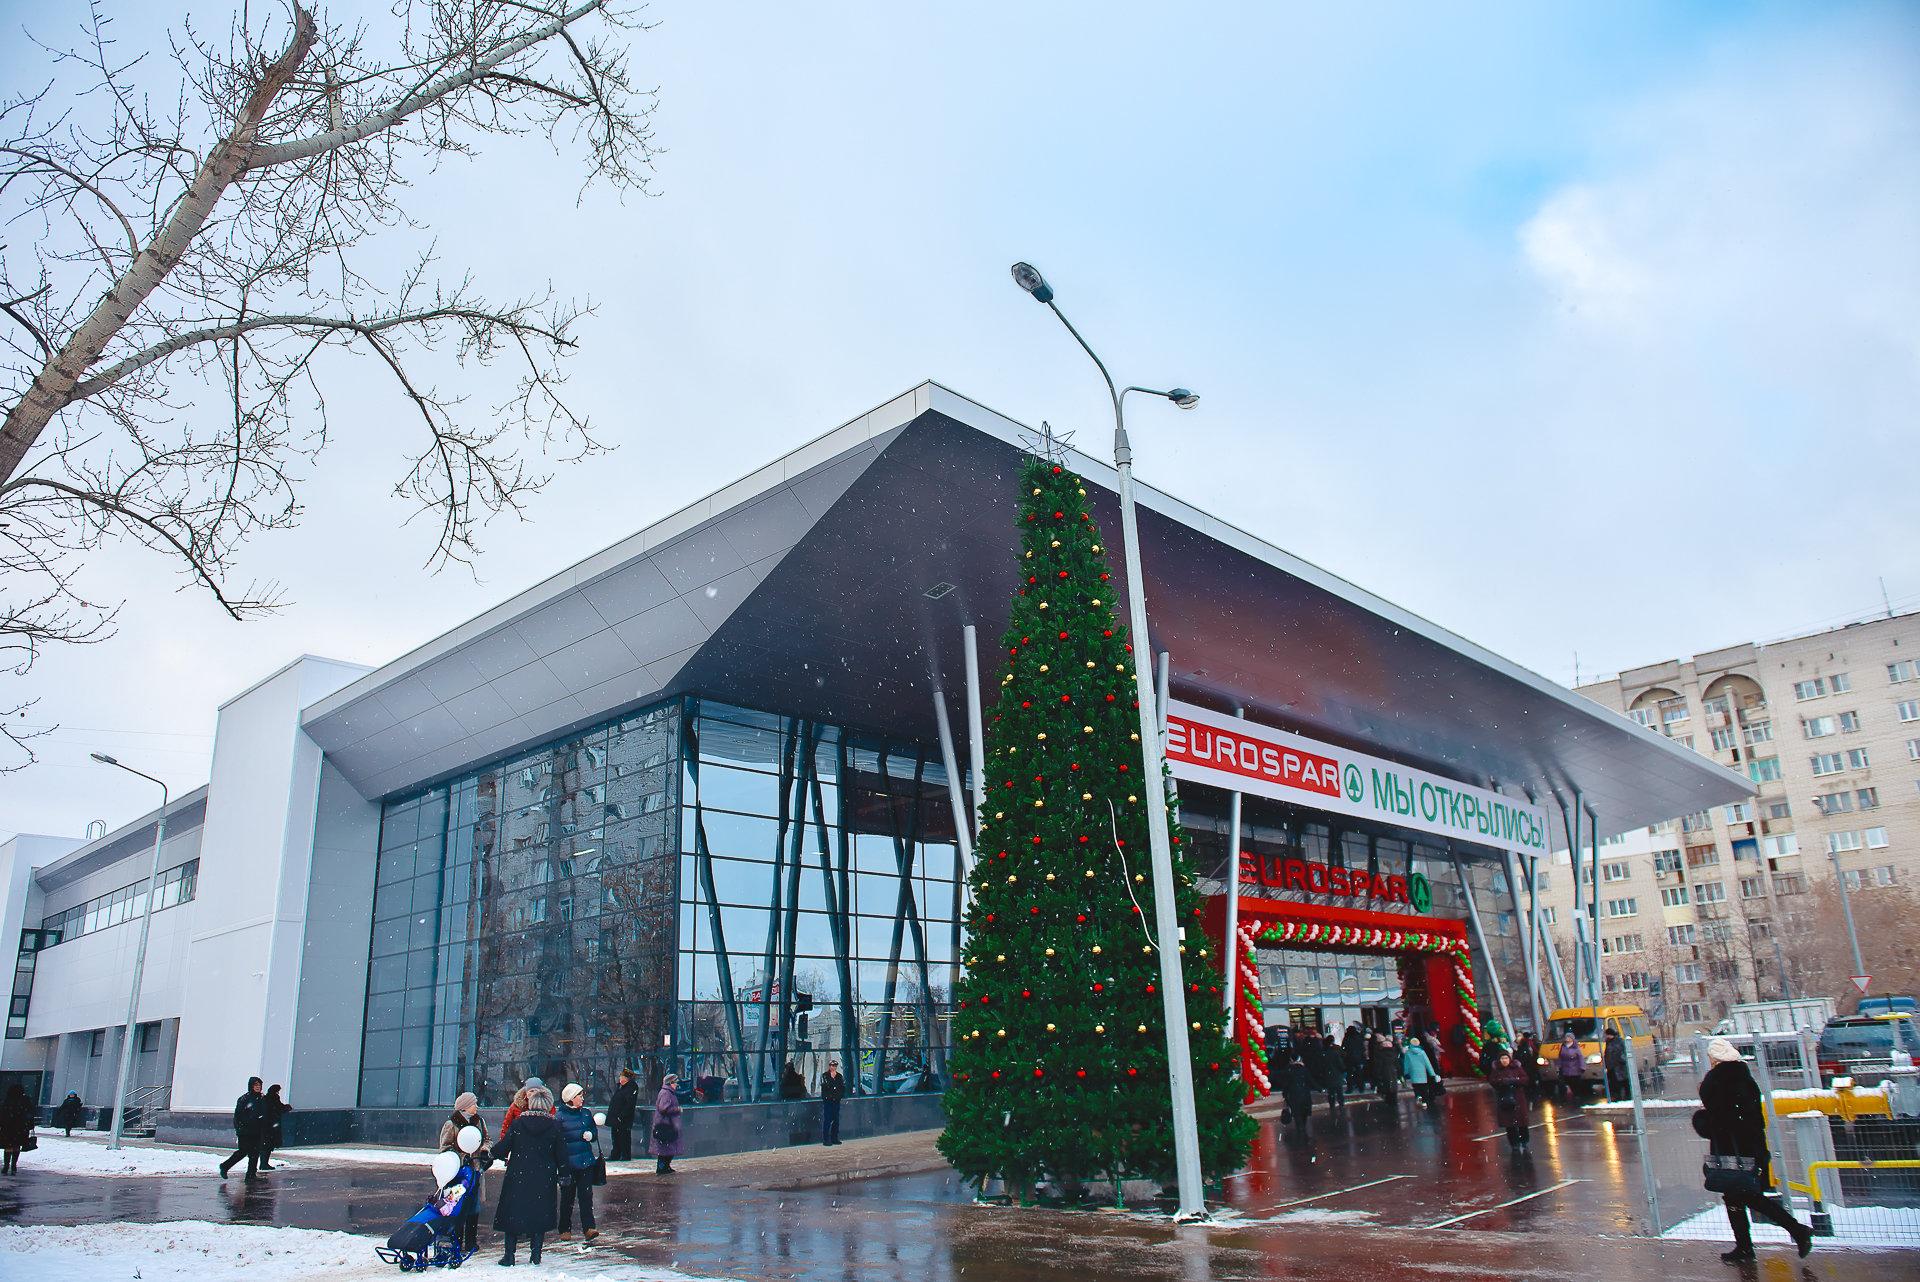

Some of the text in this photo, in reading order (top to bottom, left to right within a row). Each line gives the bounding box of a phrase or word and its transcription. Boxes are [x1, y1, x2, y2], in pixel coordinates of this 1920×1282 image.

[1166, 721, 1339, 791] EUROSPAR
[1371, 768, 1545, 849] МЫ ОТКРЫЛИСЬ!
[1238, 851, 1409, 904] EUROSPAR
